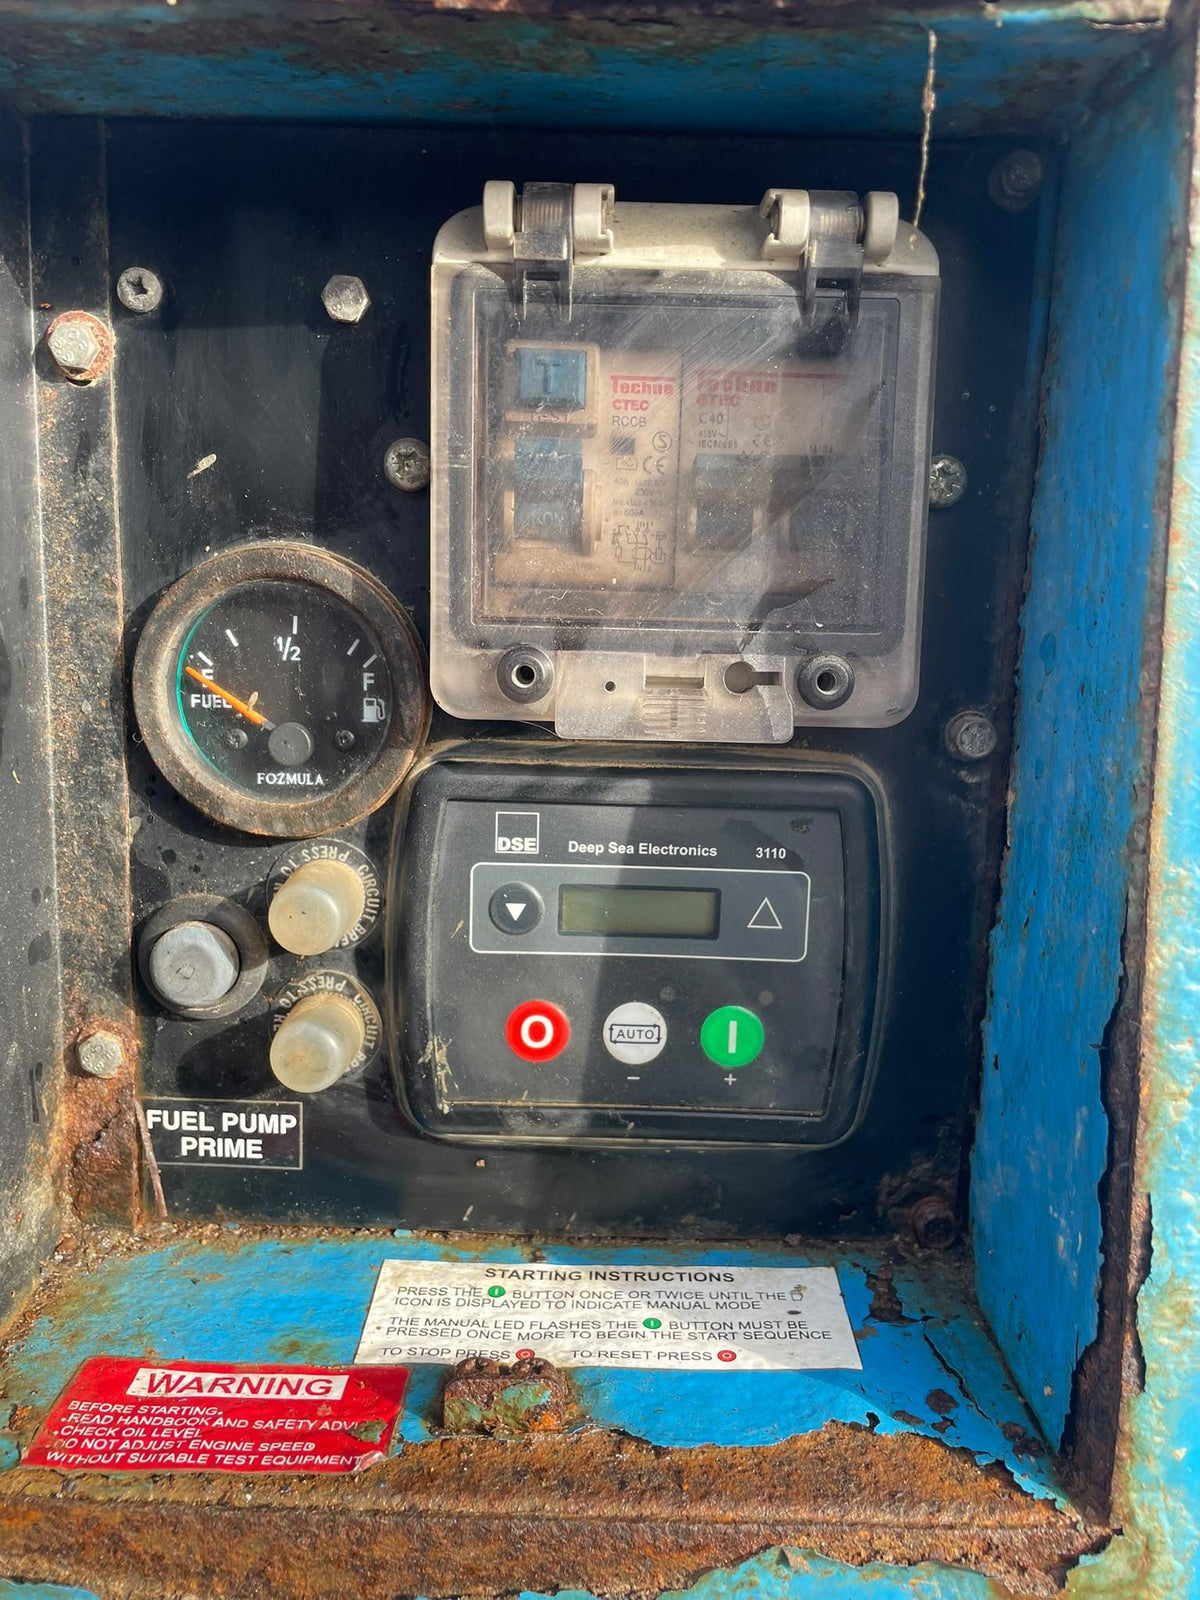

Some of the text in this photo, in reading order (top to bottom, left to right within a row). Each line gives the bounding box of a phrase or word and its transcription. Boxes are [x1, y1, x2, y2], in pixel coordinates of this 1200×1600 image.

[612, 398, 649, 411] CTEC
[611, 415, 647, 427] RCCB
[362, 672, 375, 692] F
[190, 692, 233, 710] FUEL
[256, 771, 326, 787] FOZMULA
[496, 836, 539, 853] DSE
[567, 840, 718, 858] Deep Sea Electronics
[301, 845, 351, 862] PRESS
[754, 846, 788, 861] 3110
[356, 864, 380, 923] CIRCUIT
[298, 975, 347, 994] PRESS
[616, 1029, 655, 1040] AUTO
[146, 1109, 298, 1135] FUEL PUMP
[180, 1136, 264, 1160] PRIME
[484, 1268, 735, 1283] STARTING INSTRUCTIONS
[397, 1286, 787, 1301] PRESS THE BUTTON ONCE OR TWICE UNTIL THE
[394, 1297, 762, 1310] ICON IS DISPLAYED TO INDICATE MANUAL MODE
[389, 1316, 808, 1331] THE MANUAL LED FLASHES THE BUTTON MUST BE
[385, 1326, 832, 1341] PRESSED ONCE MORE TO BEGIN THE START SEQUENCE
[381, 1347, 511, 1360] TO STOP PRESS
[571, 1350, 713, 1361] TO RESET PRESS
[147, 1373, 333, 1396] WARNING
[67, 1400, 136, 1413] BEFORE
[116, 1415, 212, 1427] HANDBOOK
[212, 1417, 249, 1428] AND
[252, 1419, 319, 1430] SAFETY
[60, 1425, 203, 1439] CHECK OIL LEVEL
[80, 1439, 119, 1450] NOT
[118, 1440, 187, 1451] ADJUST
[188, 1440, 254, 1451] ENGINE
[257, 1442, 316, 1452] SPEED
[46, 1451, 362, 1465] WITHOUT SUITABLE TEST EQUIPMENT
